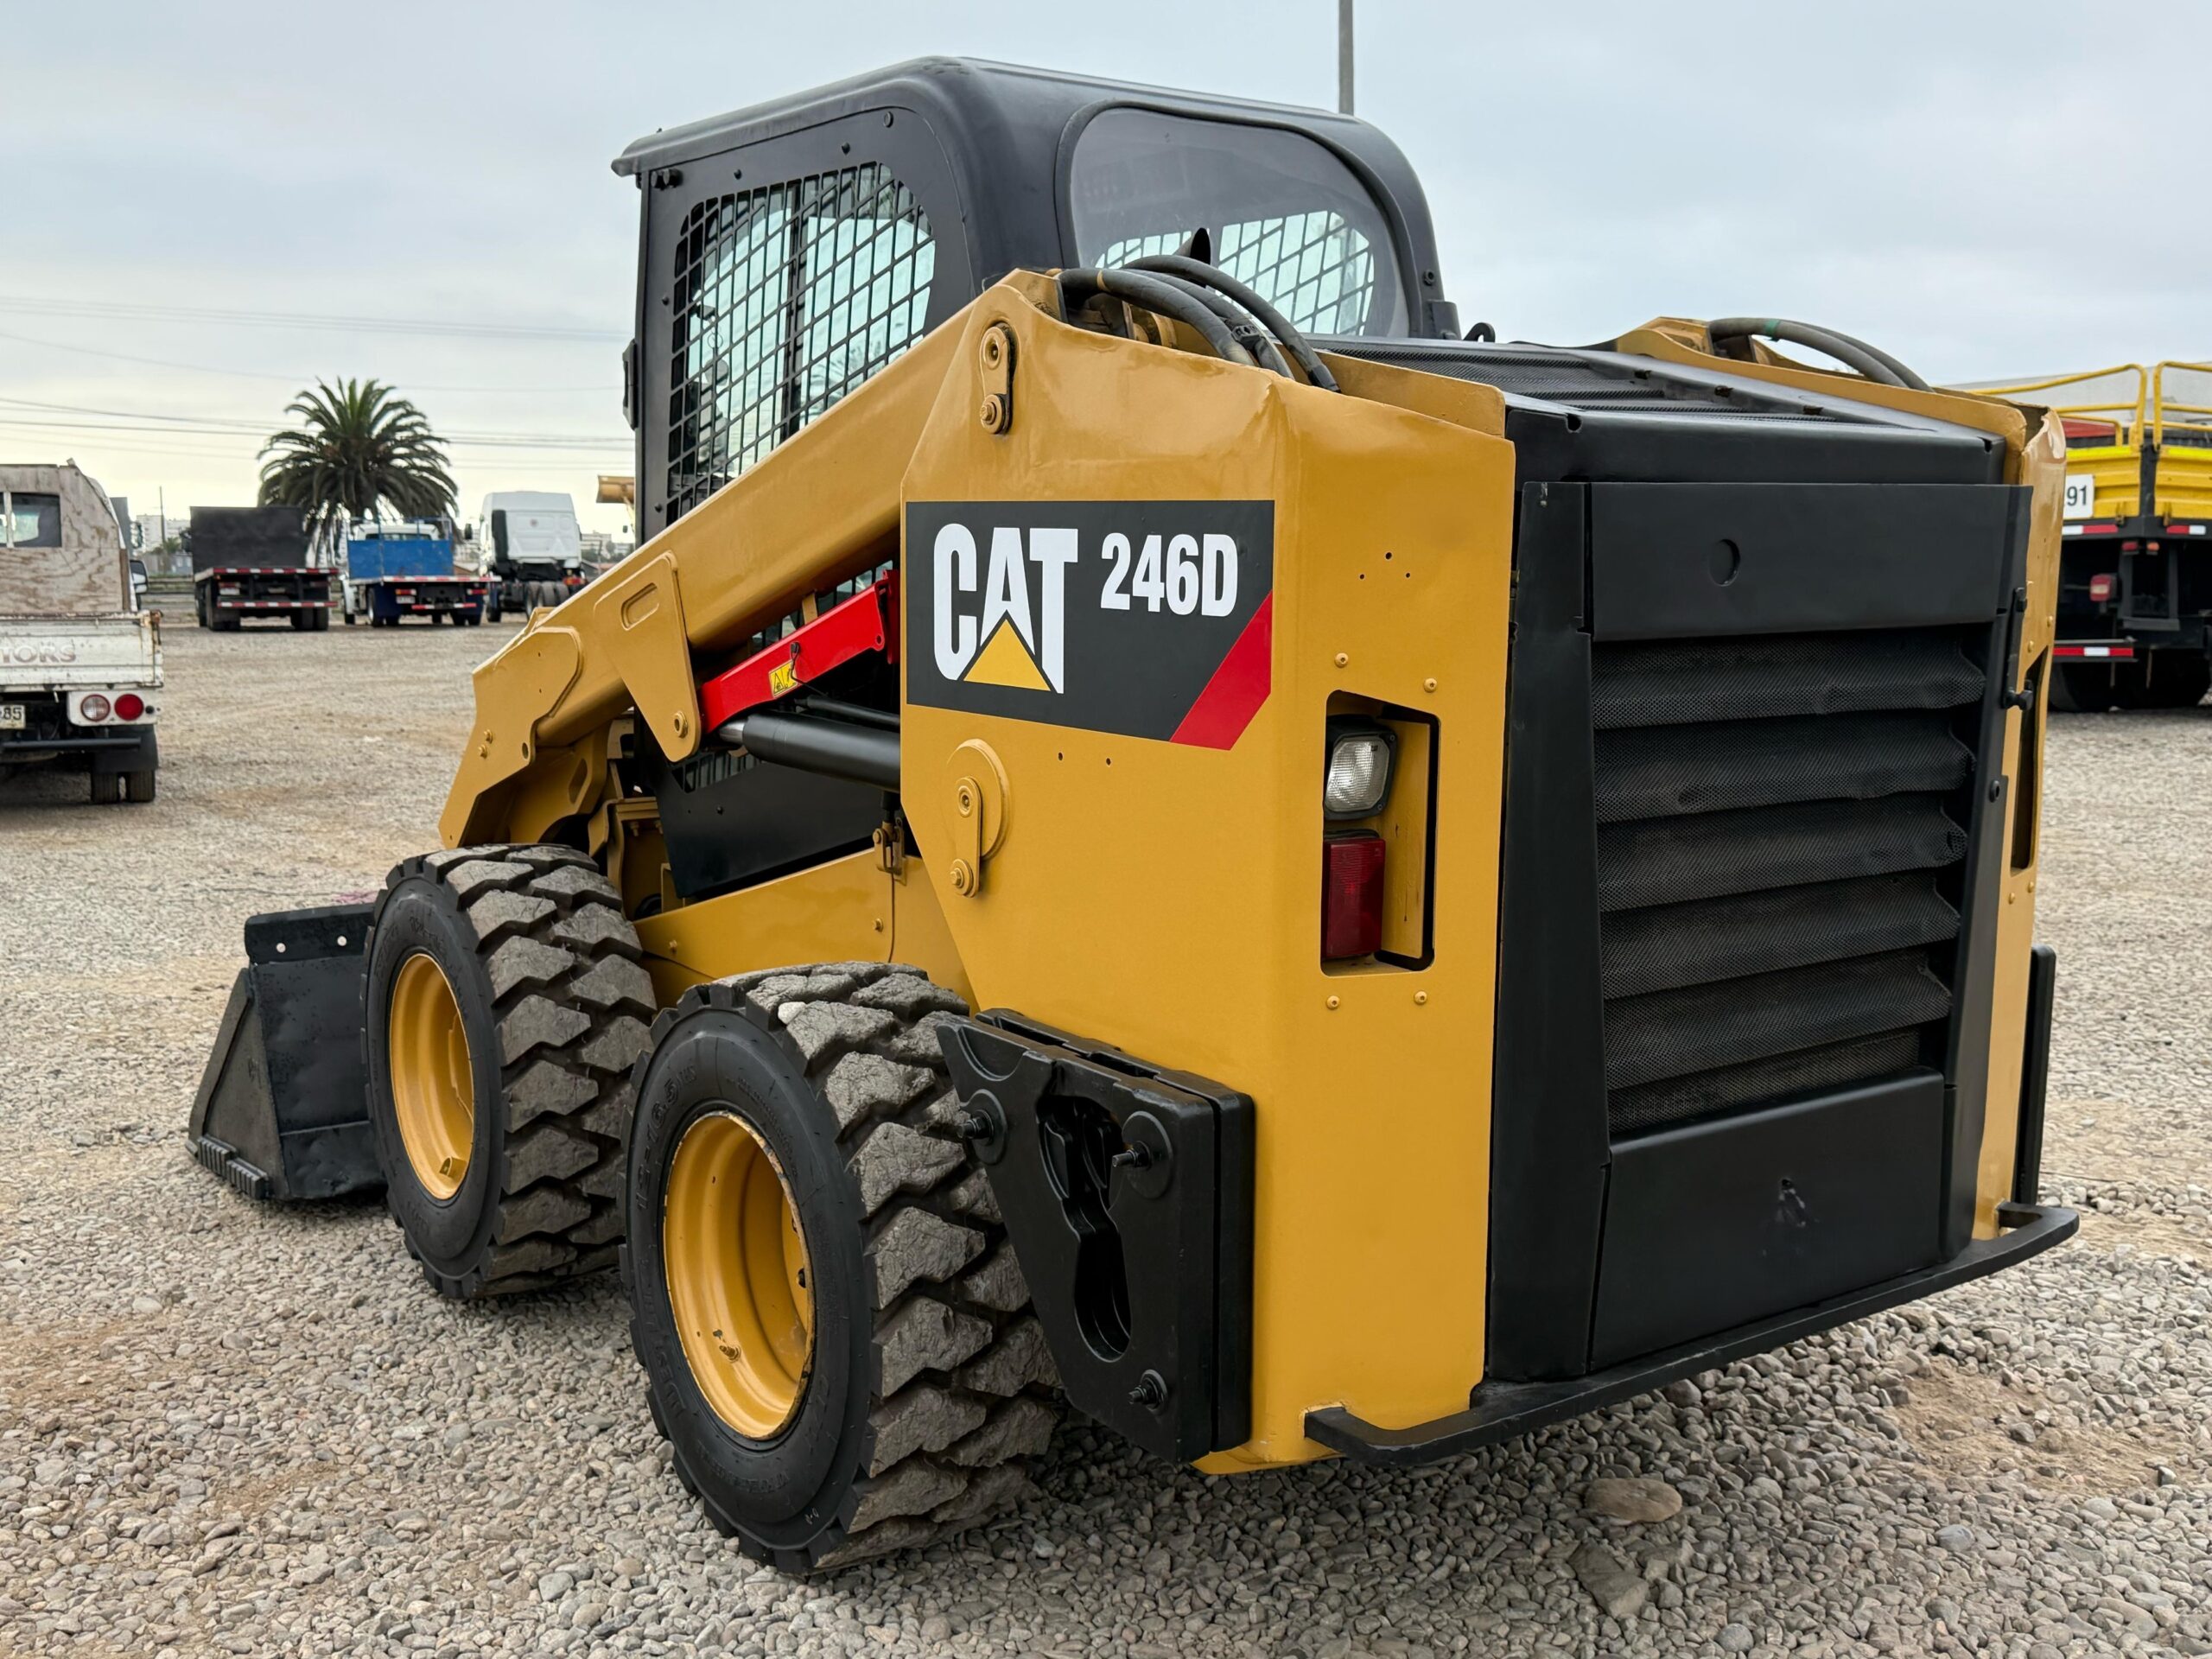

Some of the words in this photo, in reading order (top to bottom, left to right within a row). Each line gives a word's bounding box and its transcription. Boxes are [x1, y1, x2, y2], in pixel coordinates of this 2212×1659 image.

[2067, 485, 2087, 506] 91
[934, 524, 1078, 695] CAT
[1100, 532, 1238, 617] 246D
